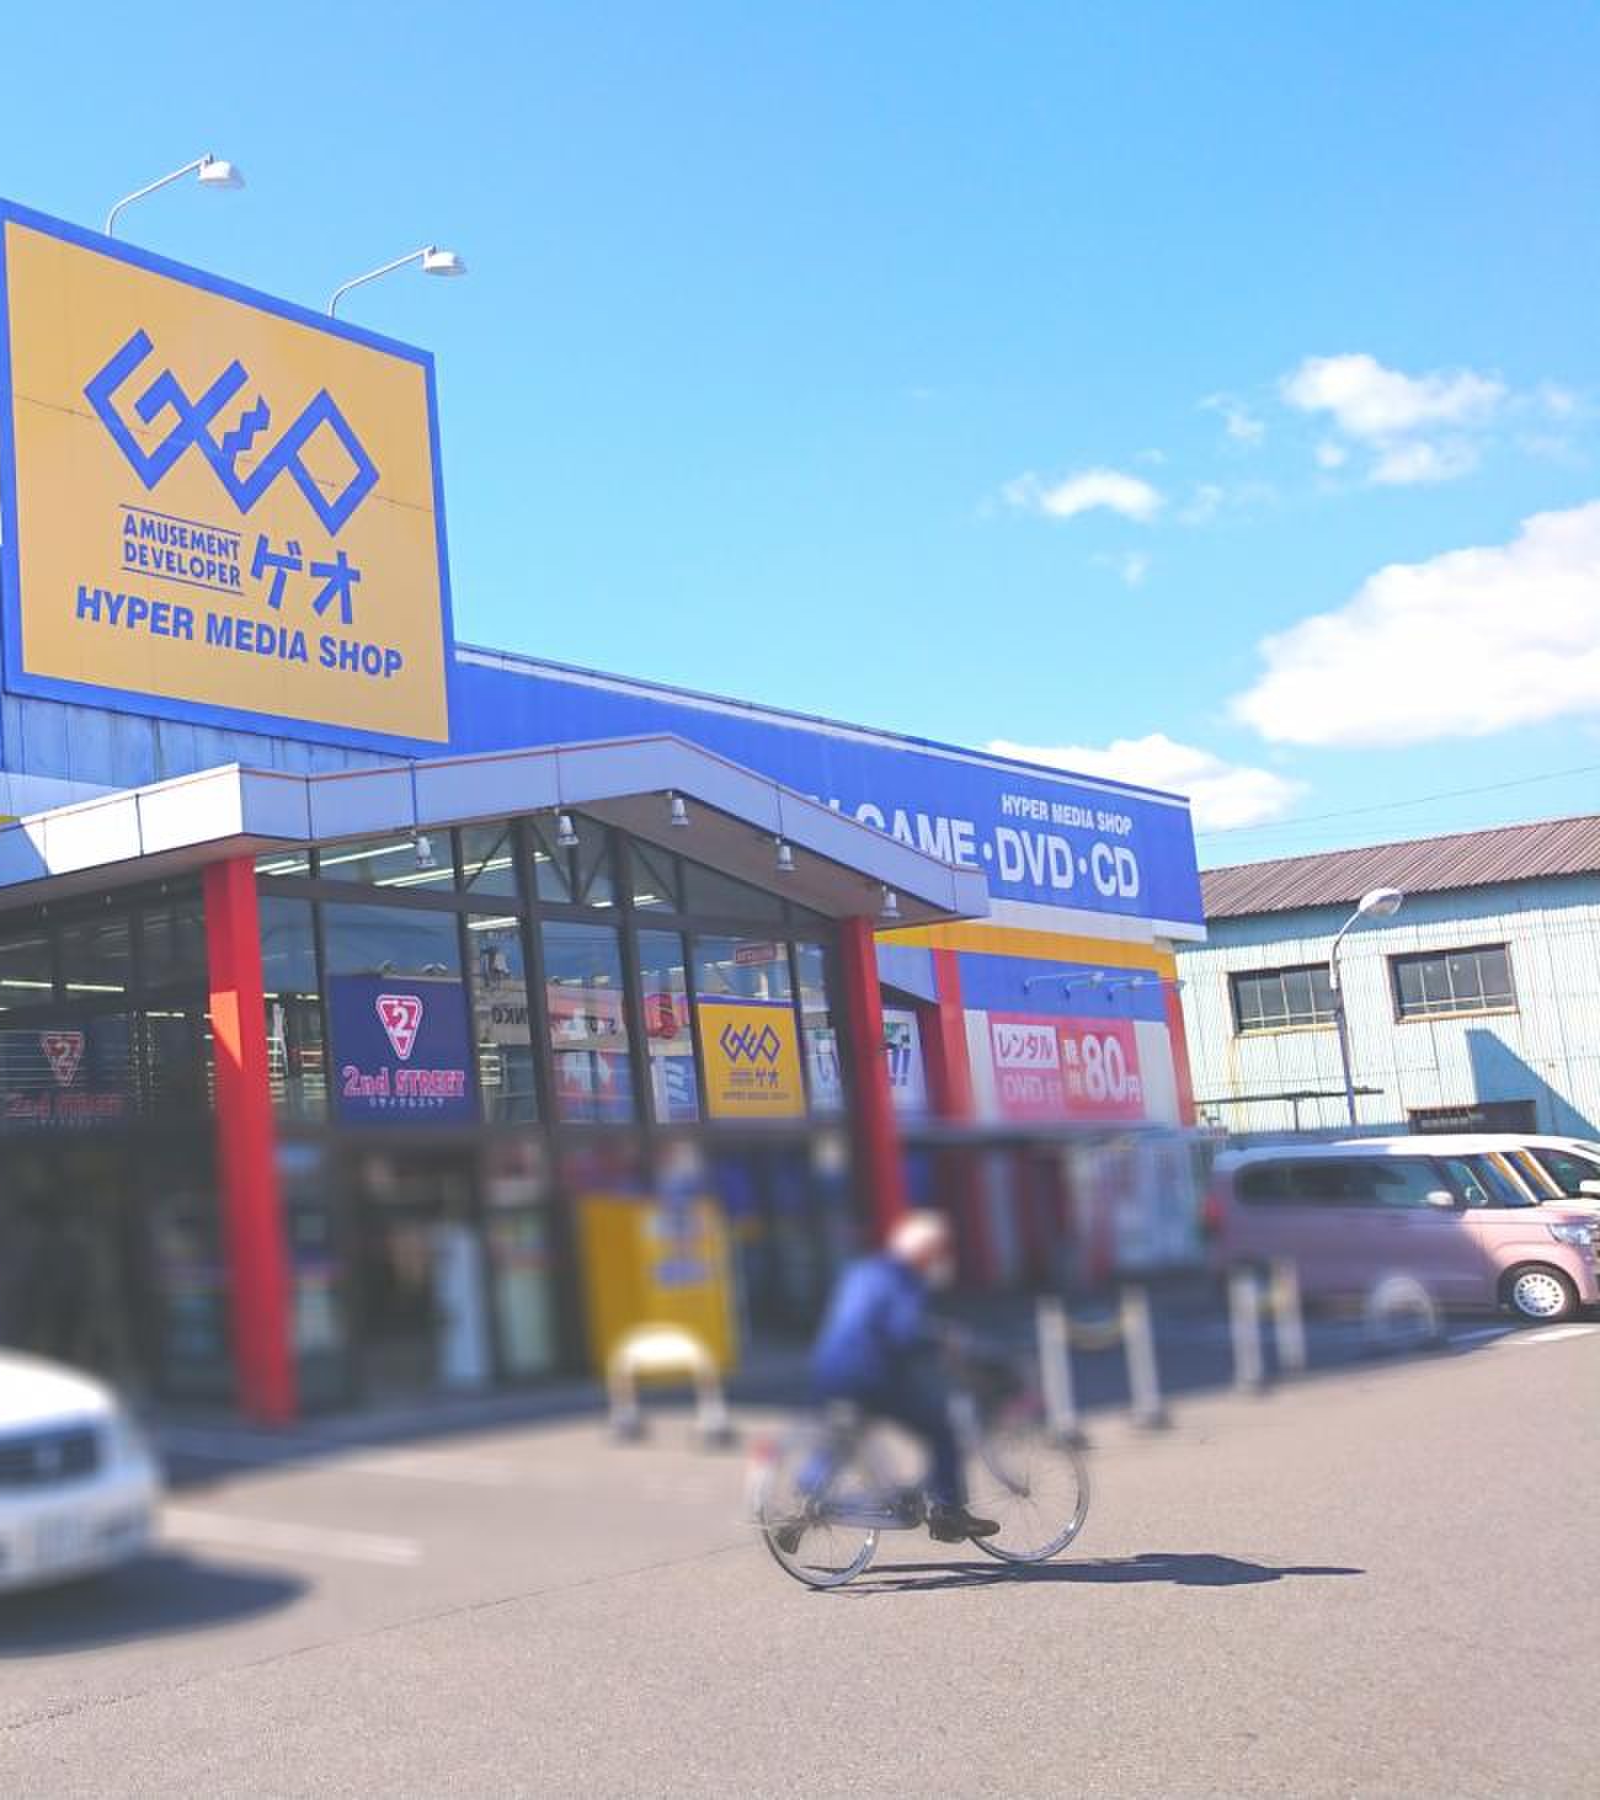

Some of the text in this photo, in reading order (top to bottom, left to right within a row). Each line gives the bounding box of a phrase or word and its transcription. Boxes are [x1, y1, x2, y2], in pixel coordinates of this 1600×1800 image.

[123, 513, 241, 561] AMUSEMENT
[124, 540, 241, 588] DEVELOPER
[249, 533, 361, 625] ゲオ
[75, 585, 403, 679] HYPER MEDIA SHOP
[1001, 793, 1133, 837] HYPER MEDIA SHOP
[998, 1031, 1055, 1060] レンタル
[342, 1065, 390, 1097] 2nd
